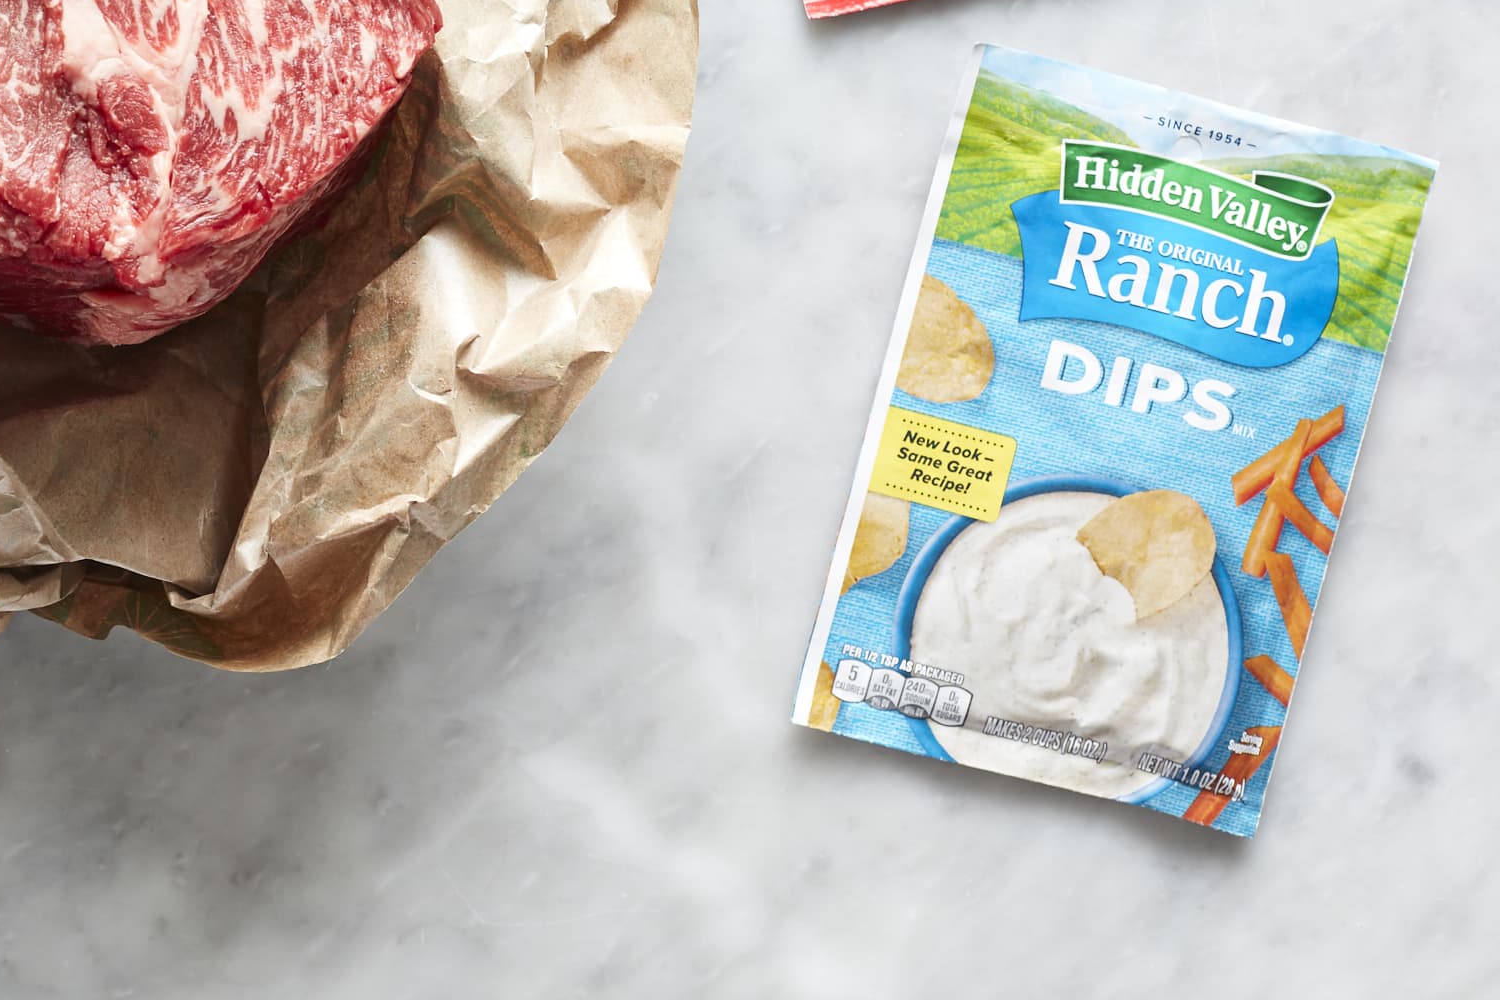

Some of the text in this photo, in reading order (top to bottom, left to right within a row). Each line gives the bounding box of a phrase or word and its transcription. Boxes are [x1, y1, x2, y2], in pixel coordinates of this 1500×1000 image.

[1157, 116, 1242, 147] SINCE 1954
[1073, 155, 1309, 252] Hidden Valley
[1116, 228, 1245, 276] THE ORIGINAL
[1048, 220, 1288, 345] Ranch
[1040, 339, 1238, 433] DIPS
[902, 430, 941, 450] New
[942, 440, 983, 462] Look
[1232, 423, 1258, 440] MIX
[896, 446, 994, 483] Same Great
[909, 467, 972, 495] Recipe!
[842, 644, 965, 686] PER 1/2 TSP AS PACKAGED
[848, 665, 860, 682] 5
[834, 680, 866, 697] CALORIES
[884, 687, 898, 698] FAT
[941, 702, 961, 714] TOTAL
[983, 716, 1024, 741] MAKES
[1023, 726, 1033, 743] 2
[1032, 727, 1063, 751] CUPS
[1061, 731, 1082, 755] (16
[1138, 752, 1162, 774] NET
[1161, 758, 1182, 779] WT
[1180, 767, 1201, 786] 1.0
[1198, 772, 1217, 791] OZ
